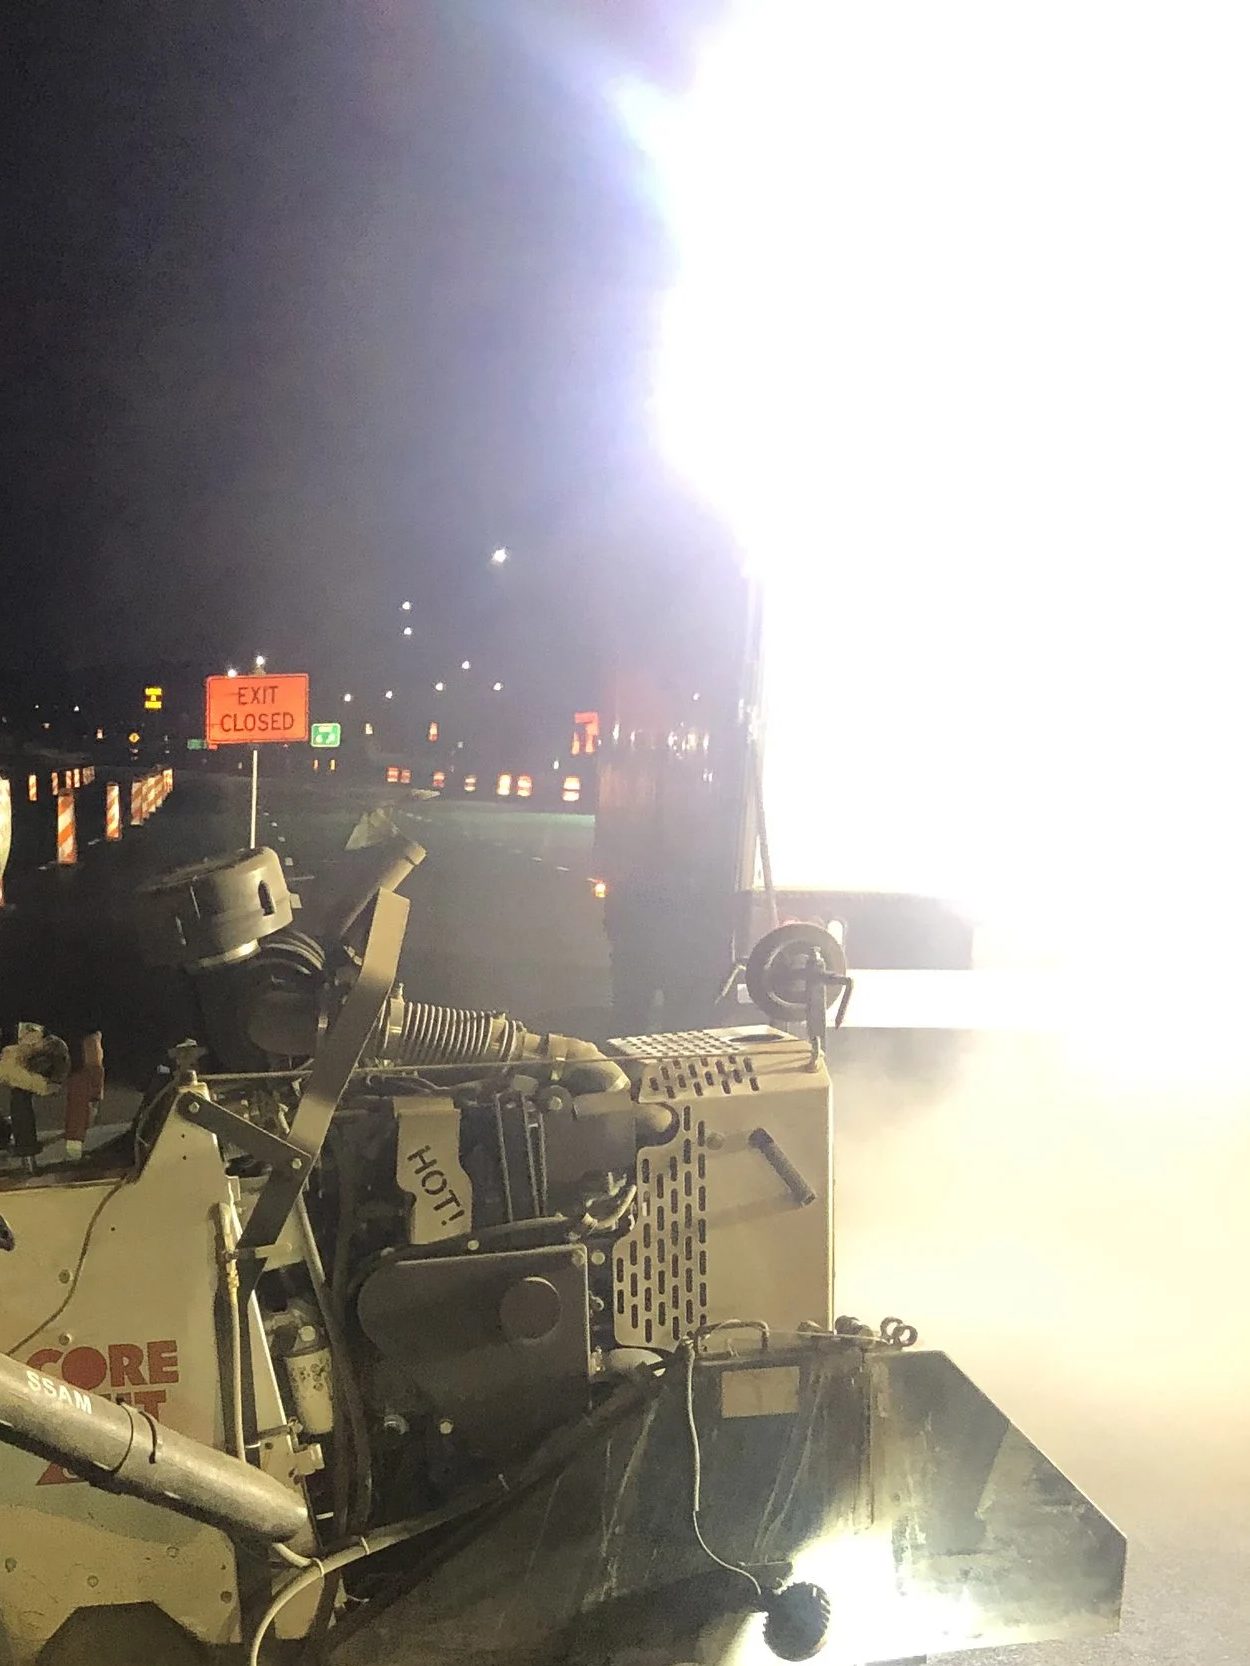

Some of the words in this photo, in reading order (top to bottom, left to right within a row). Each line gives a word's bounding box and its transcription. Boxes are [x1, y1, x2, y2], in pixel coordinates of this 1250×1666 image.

[237, 685, 279, 706] EXIT
[220, 711, 295, 733] CLOSED
[406, 1144, 466, 1226] HOT!
[25, 1369, 93, 1416] SSAM
